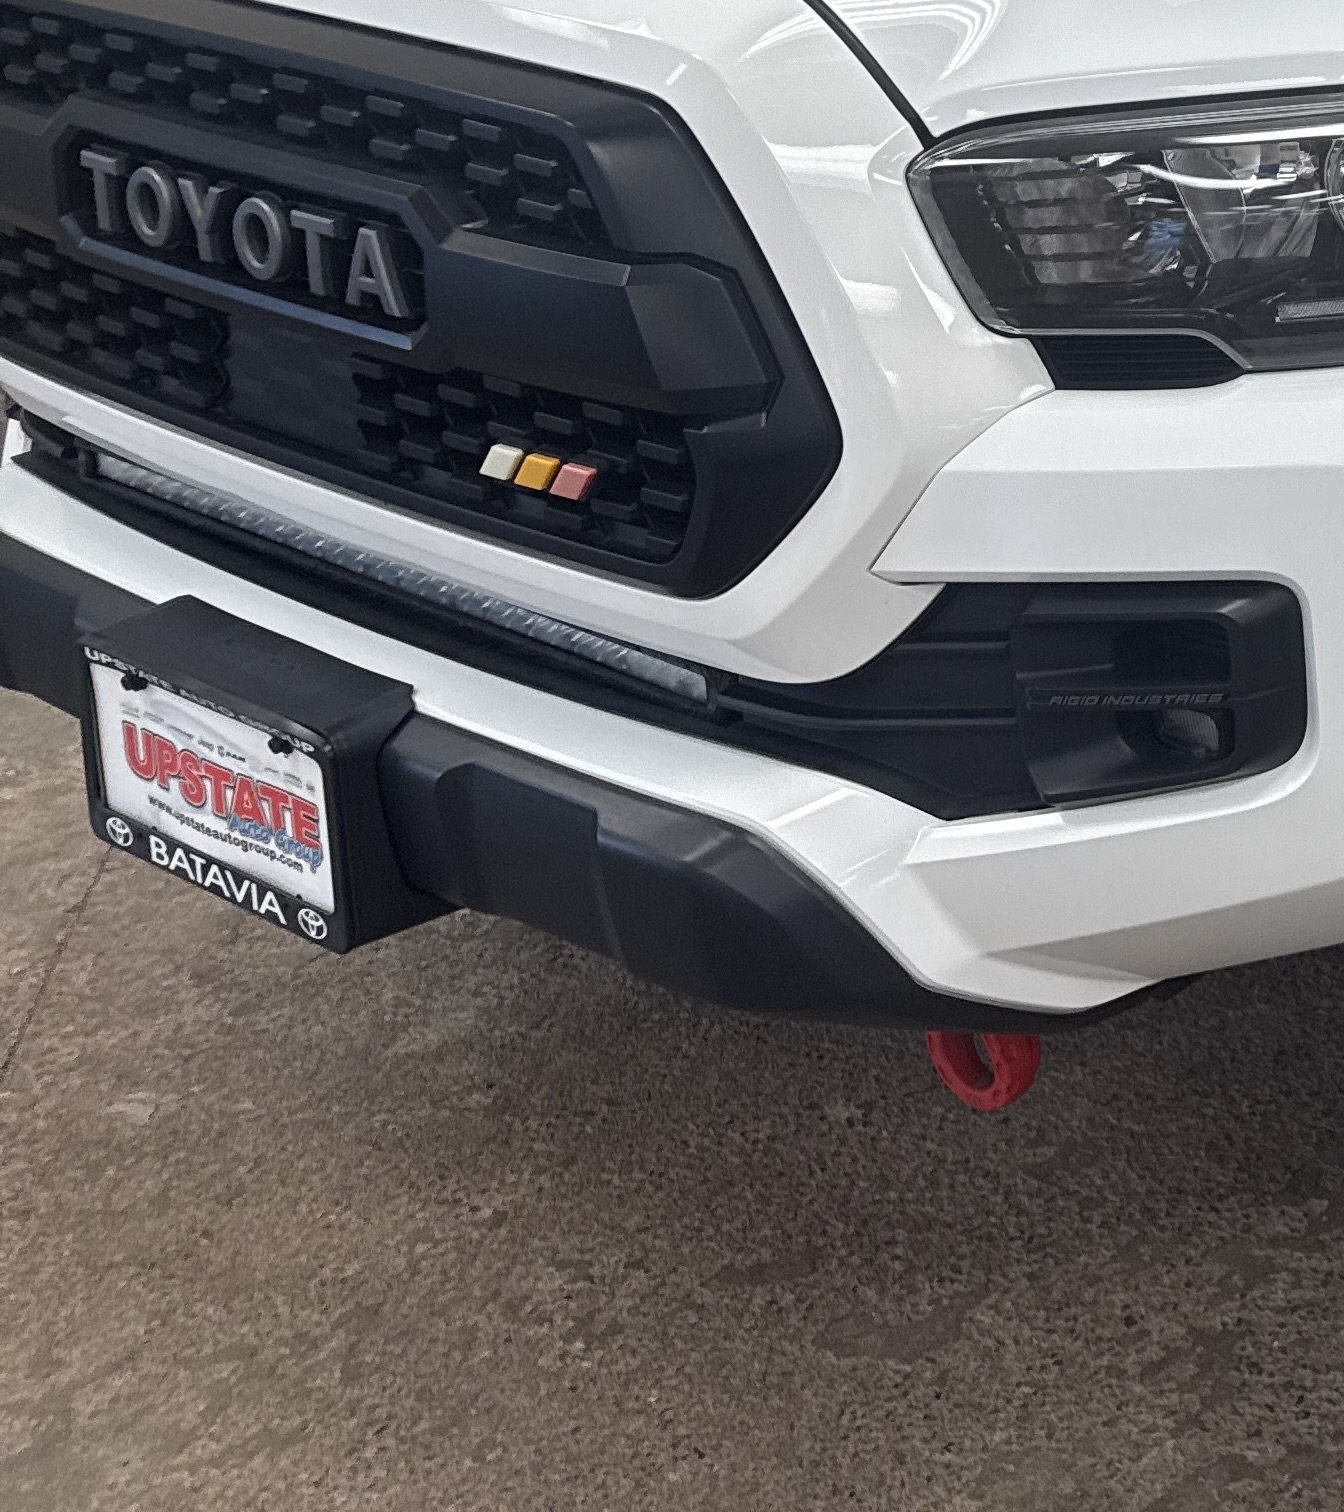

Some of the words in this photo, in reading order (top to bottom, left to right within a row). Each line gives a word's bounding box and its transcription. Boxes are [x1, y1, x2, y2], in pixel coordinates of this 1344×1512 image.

[79, 147, 406, 318] TOYOTA
[1049, 694, 1100, 706] RIGID
[1101, 693, 1225, 706] INDUSTRIES
[122, 720, 322, 850] UPSTATE
[148, 794, 304, 874] www.upstateautogroup.com
[228, 814, 273, 845] Auto
[149, 835, 288, 926] BATAVIA
